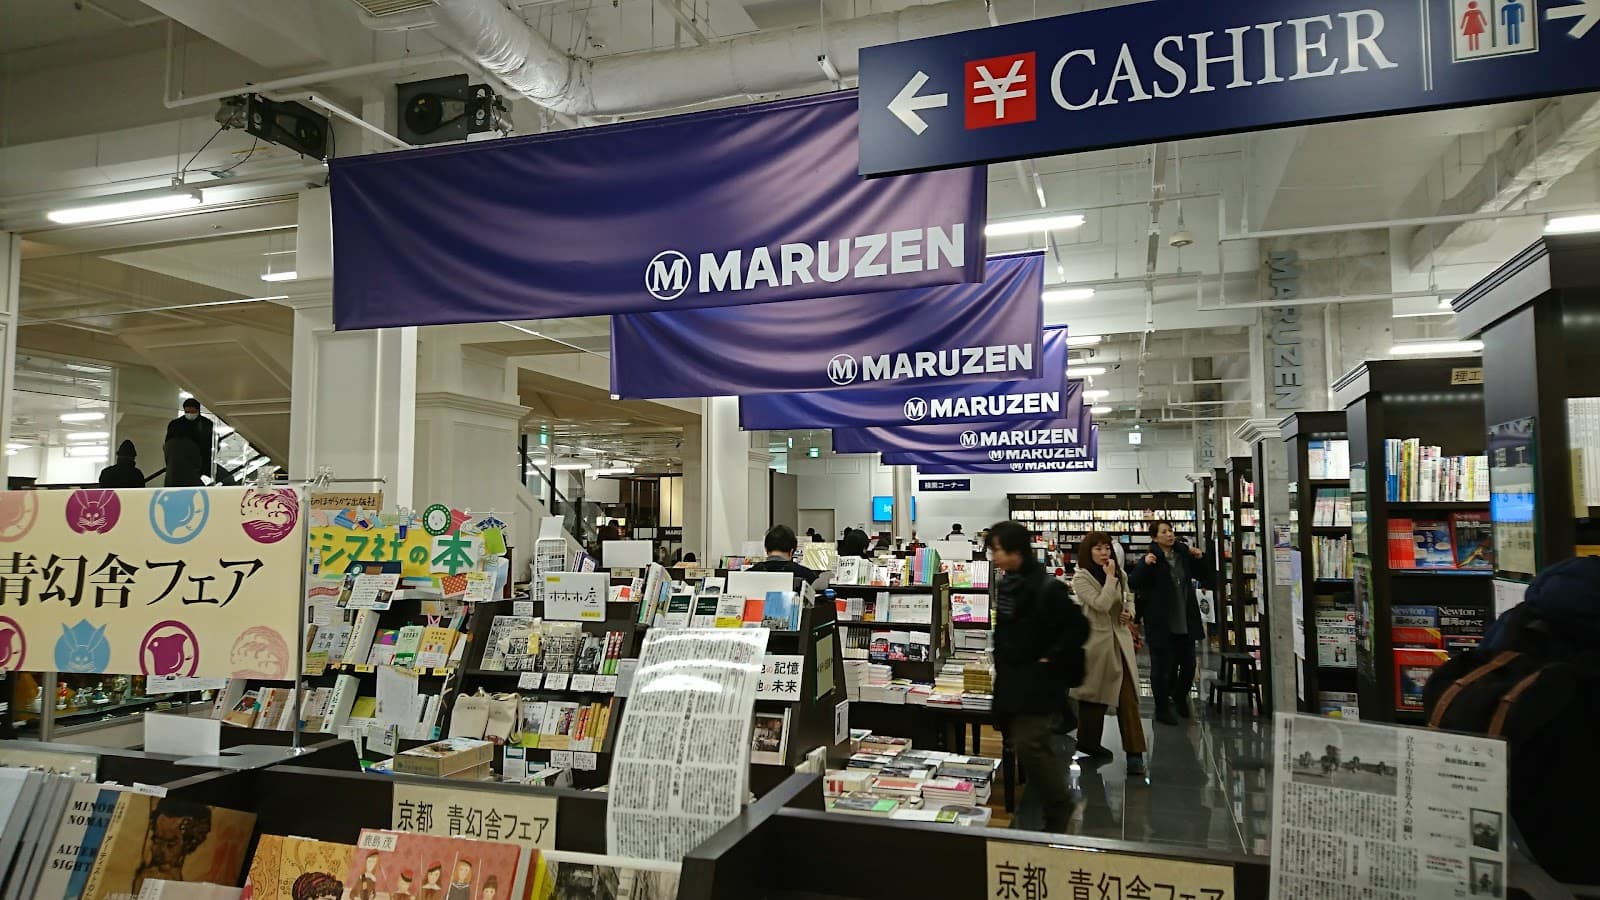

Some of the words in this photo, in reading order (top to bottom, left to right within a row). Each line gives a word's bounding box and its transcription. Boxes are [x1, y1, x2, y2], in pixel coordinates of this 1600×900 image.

[1049, 8, 1399, 112] CASHIER
[698, 222, 966, 294] MARUZEN
[1269, 250, 1304, 410] MARUZEN
[862, 343, 1033, 381] MARUZEN
[931, 391, 1060, 419] MARUZEN
[980, 428, 1078, 447] MARUZEN
[1005, 445, 1087, 460] MARUZEN
[309, 530, 475, 576] シマ社の本
[0, 551, 265, 609] 青幻舎フェア
[1438, 606, 1476, 616] Newton
[72, 800, 116, 814] MINOR
[397, 800, 434, 831] 京都
[446, 804, 551, 845] 青幻舎フェア
[52, 858, 93, 873] SIGHT
[994, 860, 1049, 900] 京都
[1067, 868, 1225, 900] 青幻舎フ
